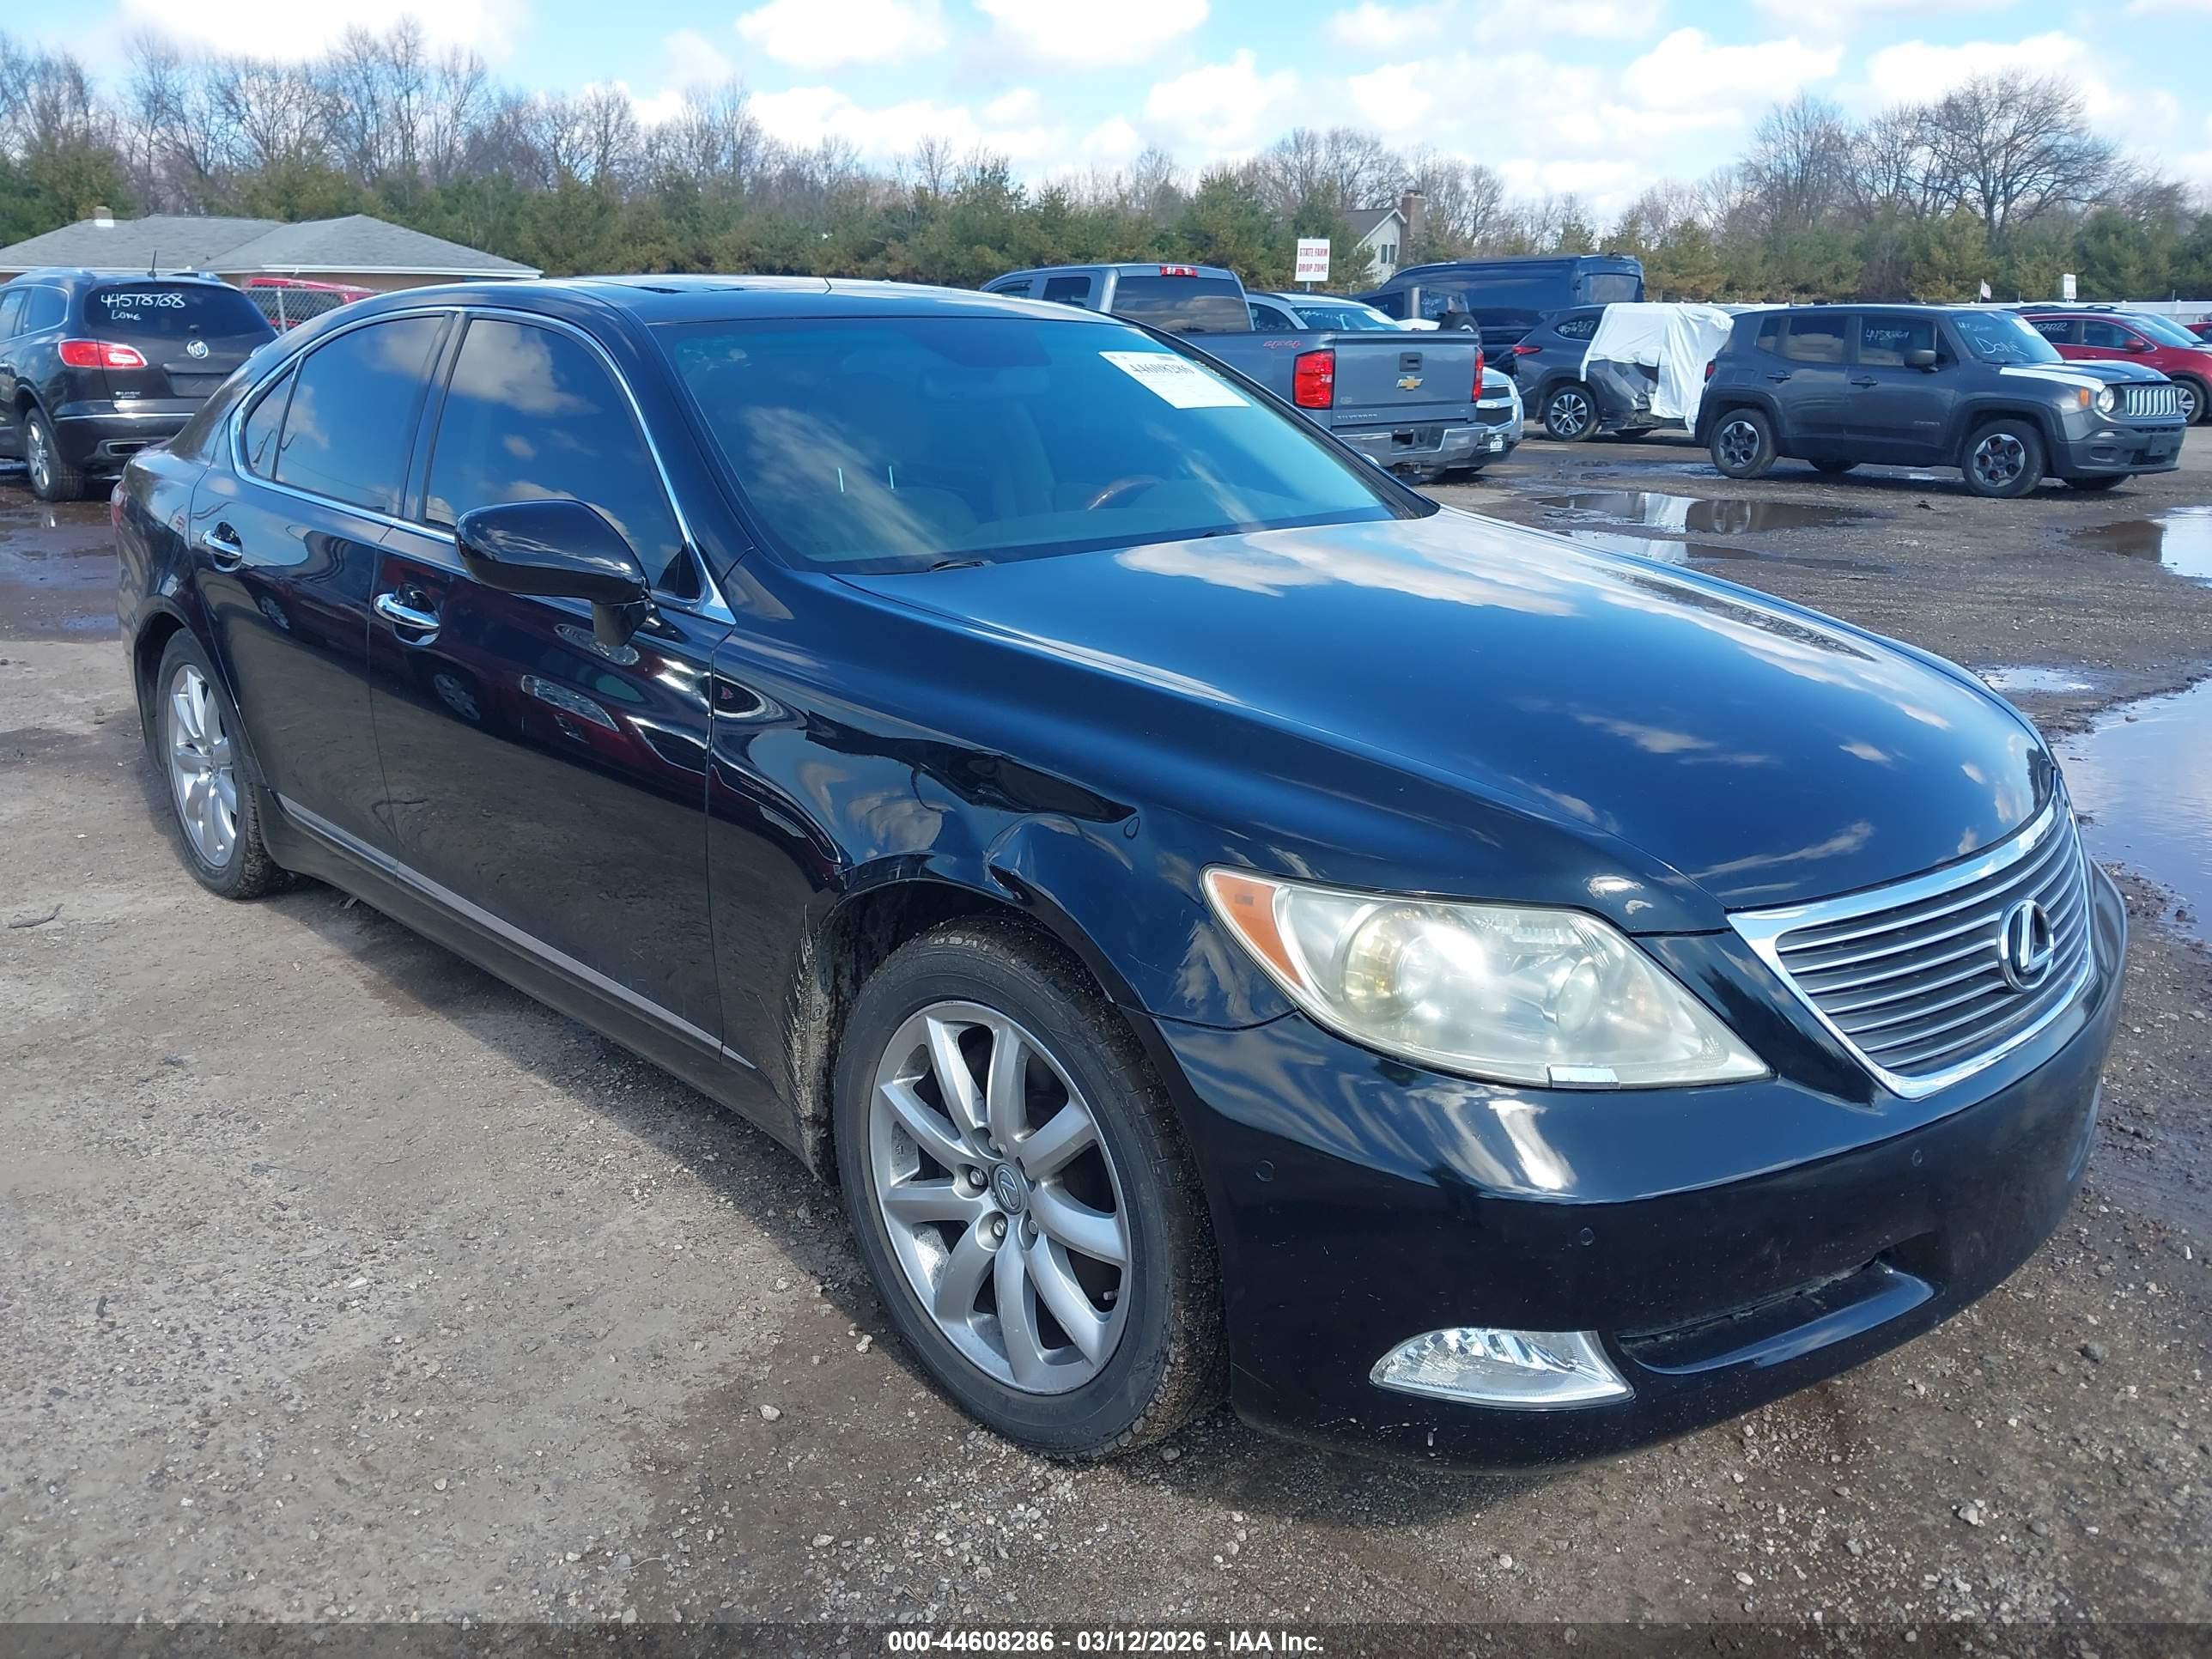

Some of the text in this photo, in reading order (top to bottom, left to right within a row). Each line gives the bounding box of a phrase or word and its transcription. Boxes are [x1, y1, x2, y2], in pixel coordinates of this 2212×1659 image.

[1299, 247, 1328, 257] STATE FARM
[1297, 263, 1328, 272] DROP ZONE
